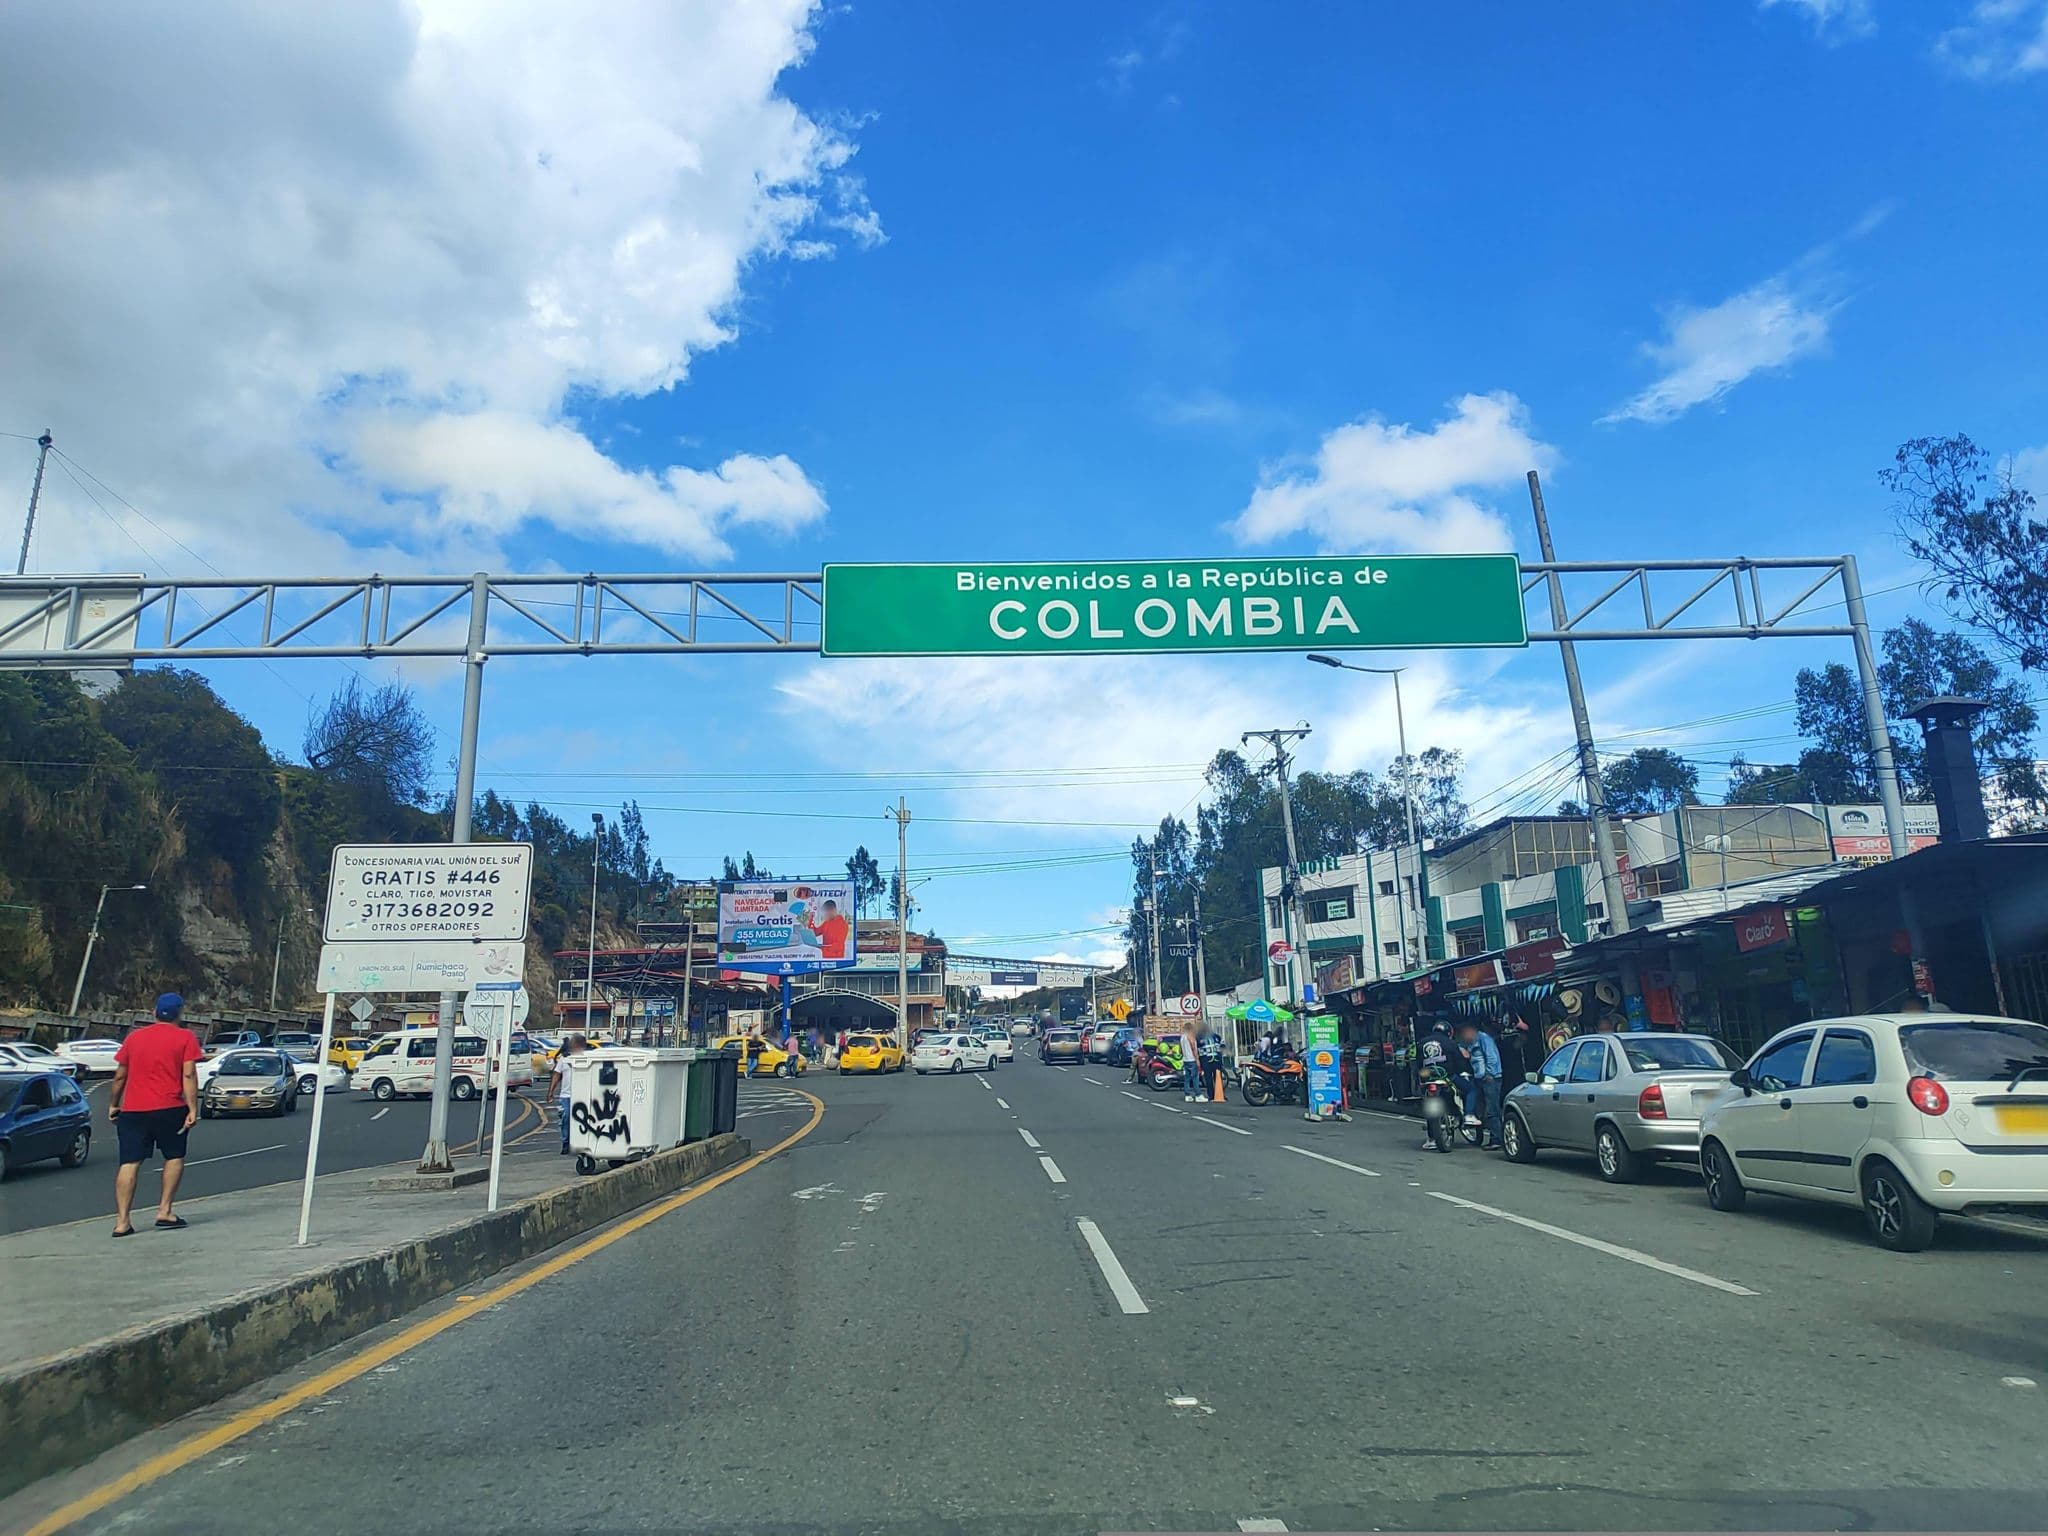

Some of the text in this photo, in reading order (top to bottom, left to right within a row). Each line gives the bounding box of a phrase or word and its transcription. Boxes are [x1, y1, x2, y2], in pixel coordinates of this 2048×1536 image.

[956, 566, 1388, 592] Bienvenidos a la República de
[989, 595, 1360, 640] COLOMBIA
[345, 855, 520, 866] CONCESIONARIA VIAL UNIÓN DEL SUR
[1299, 856, 1341, 875] HOTEL
[362, 870, 500, 885] GRATIS #446
[366, 889, 492, 899] CLARO, TIGO, MOVISTAR
[361, 902, 494, 917] 3173682092
[757, 914, 793, 925] Gratis
[371, 922, 480, 931] OTROS OPERADORES
[737, 929, 789, 939] 355 MEGAS
[1745, 924, 1772, 943] Claro
[416, 962, 464, 971] Rumichaca
[1184, 998, 1199, 1009] 20
